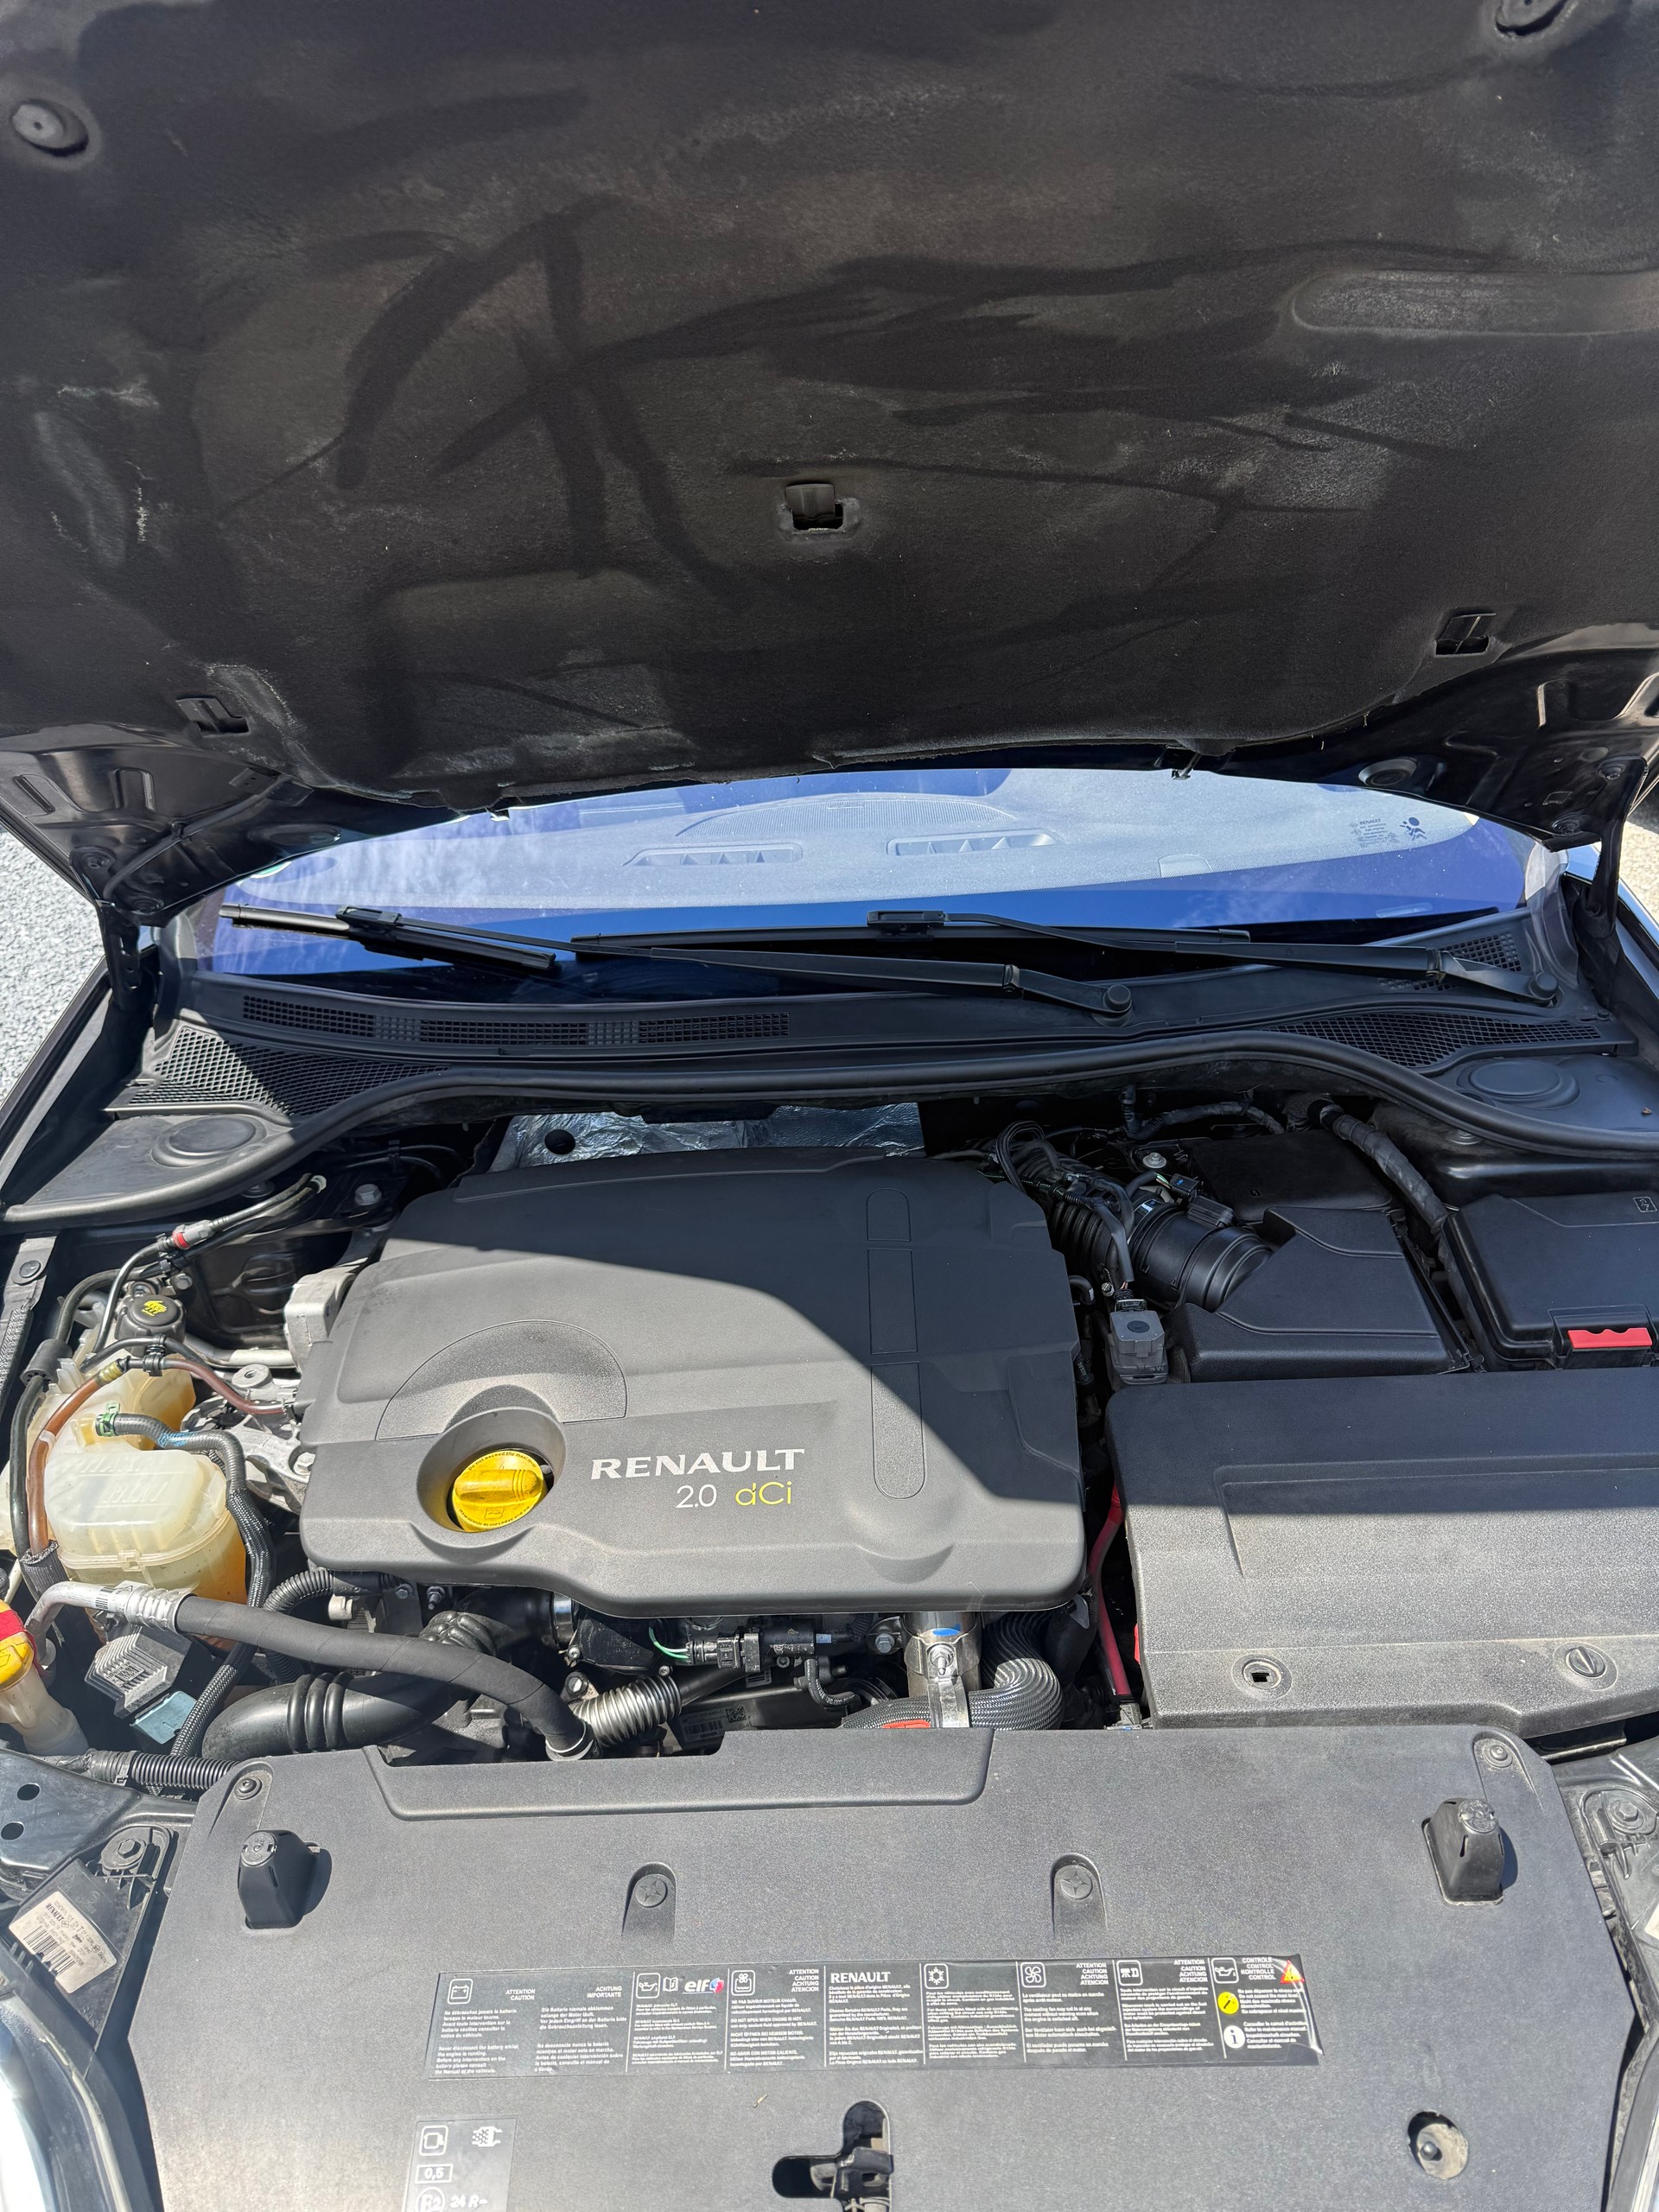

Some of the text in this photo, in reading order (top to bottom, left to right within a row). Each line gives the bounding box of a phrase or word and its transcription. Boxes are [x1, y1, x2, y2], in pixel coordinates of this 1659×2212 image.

[485, 1452, 505, 1460] exceed
[591, 1449, 804, 1479] RENAULT
[676, 1481, 792, 1508] 2.0 dCi
[45, 1903, 65, 1922] RENAULT
[830, 1972, 891, 1983] RENAULT
[684, 1980, 710, 1993] elf
[424, 2167, 444, 2180] 0,5
